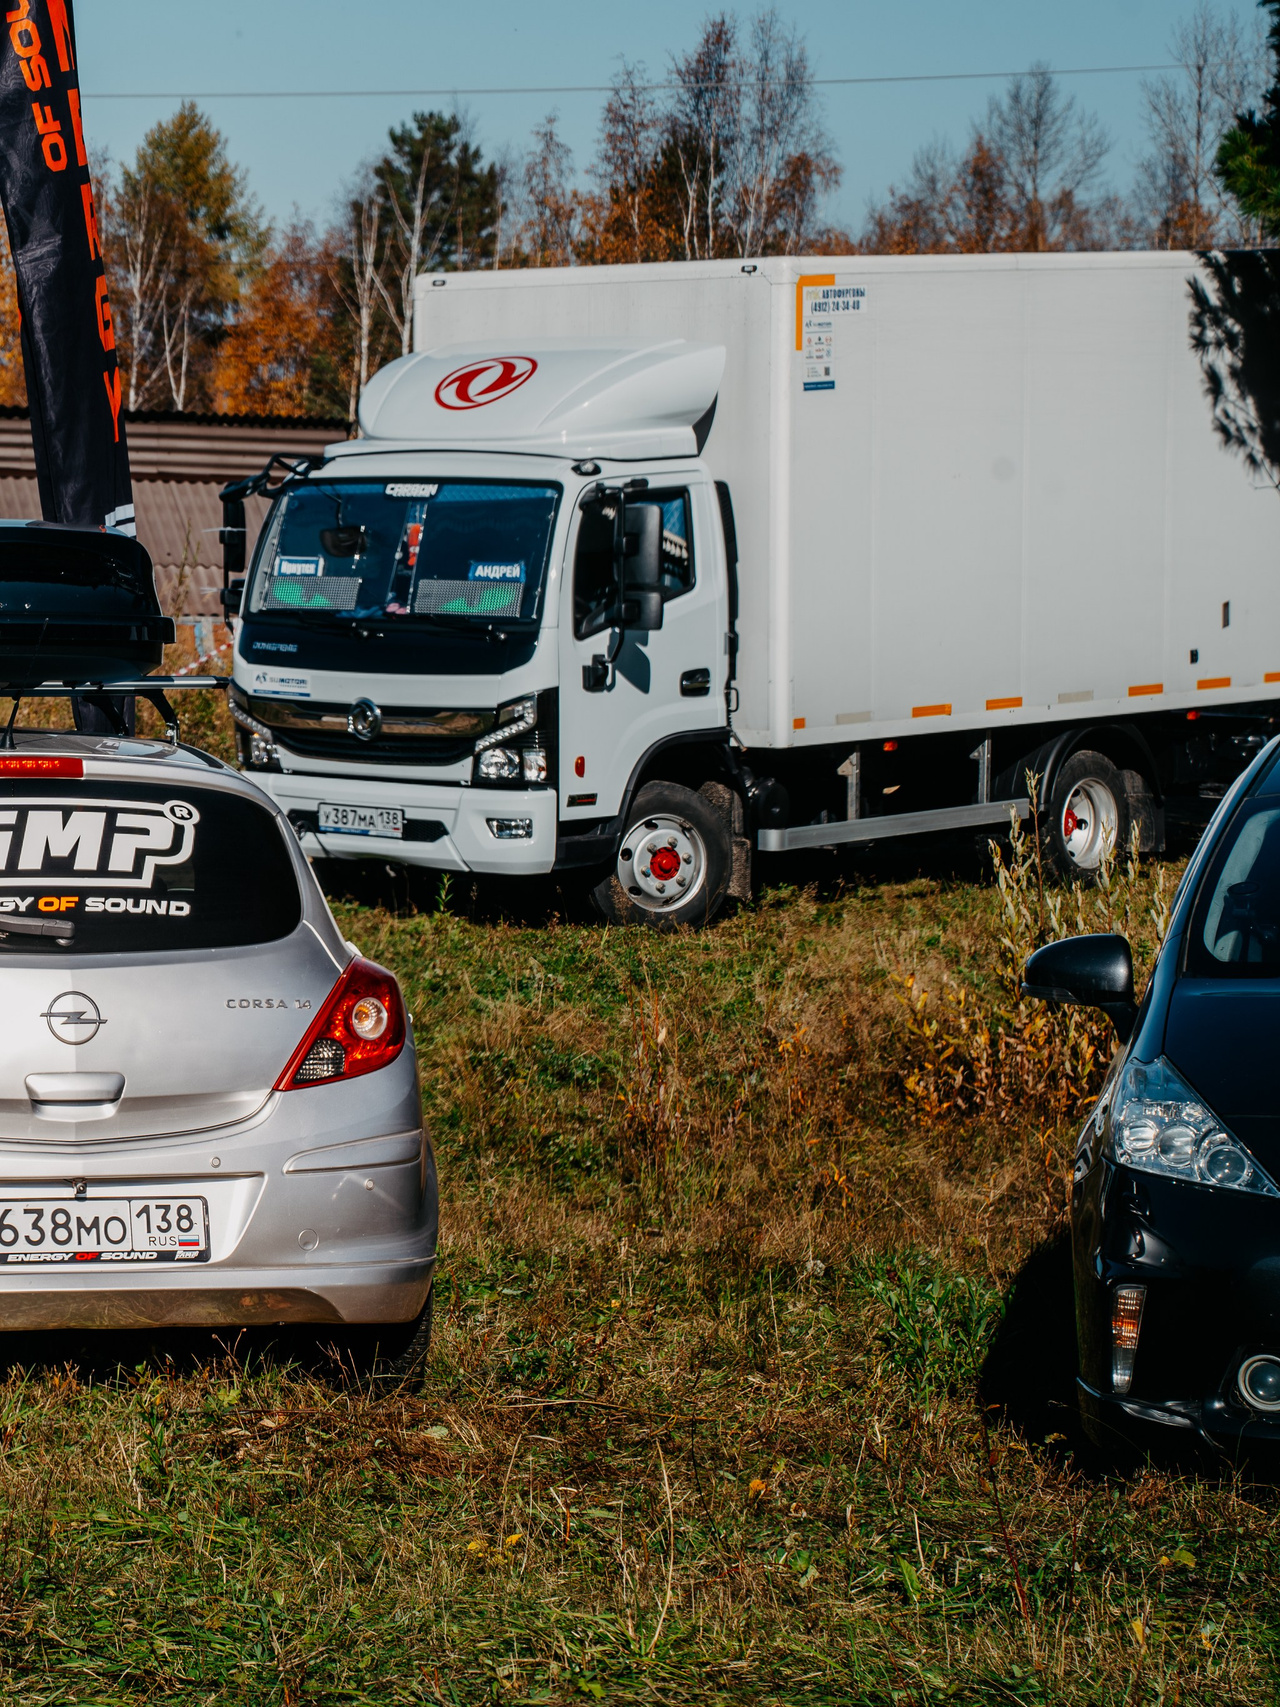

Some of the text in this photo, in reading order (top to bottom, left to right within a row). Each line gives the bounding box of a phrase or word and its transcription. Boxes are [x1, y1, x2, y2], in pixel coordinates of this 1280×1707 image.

[32, 102, 68, 172] OF
[475, 563, 521, 579] АНДРЕЙ
[378, 811, 399, 825] 138
[38, 896, 80, 912] OF
[84, 896, 191, 917] SOUND
[225, 998, 288, 1009] CORSA
[135, 1203, 194, 1234] 138
[148, 1235, 177, 1247] RUS
[7, 1252, 74, 1263] ENERGY
[75, 1252, 99, 1261] OF
[100, 1251, 158, 1261] SOUND
